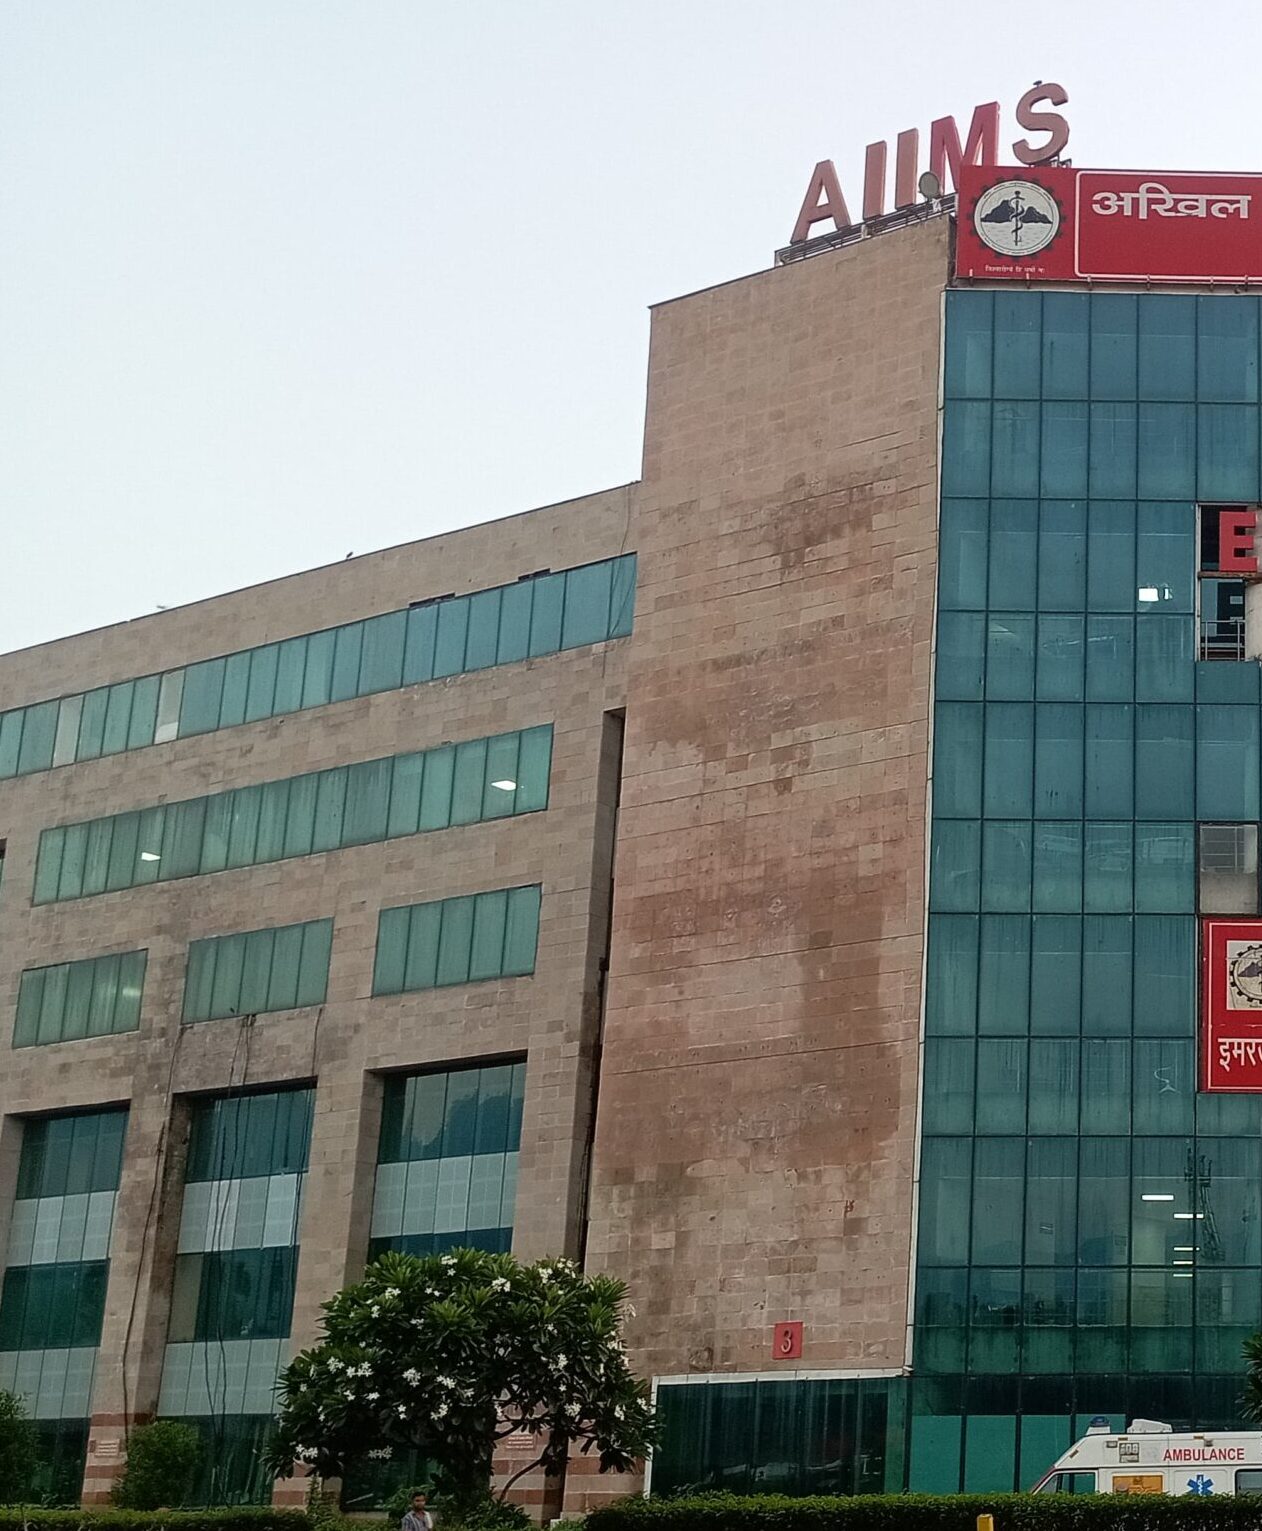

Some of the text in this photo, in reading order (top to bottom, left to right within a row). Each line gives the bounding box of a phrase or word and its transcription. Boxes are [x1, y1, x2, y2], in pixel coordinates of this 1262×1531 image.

[790, 82, 1070, 245] AIIMS
[1092, 182, 1251, 220] अखिल
[780, 1328, 793, 1354] 3
[1163, 1448, 1245, 1461] AMBULANCE
